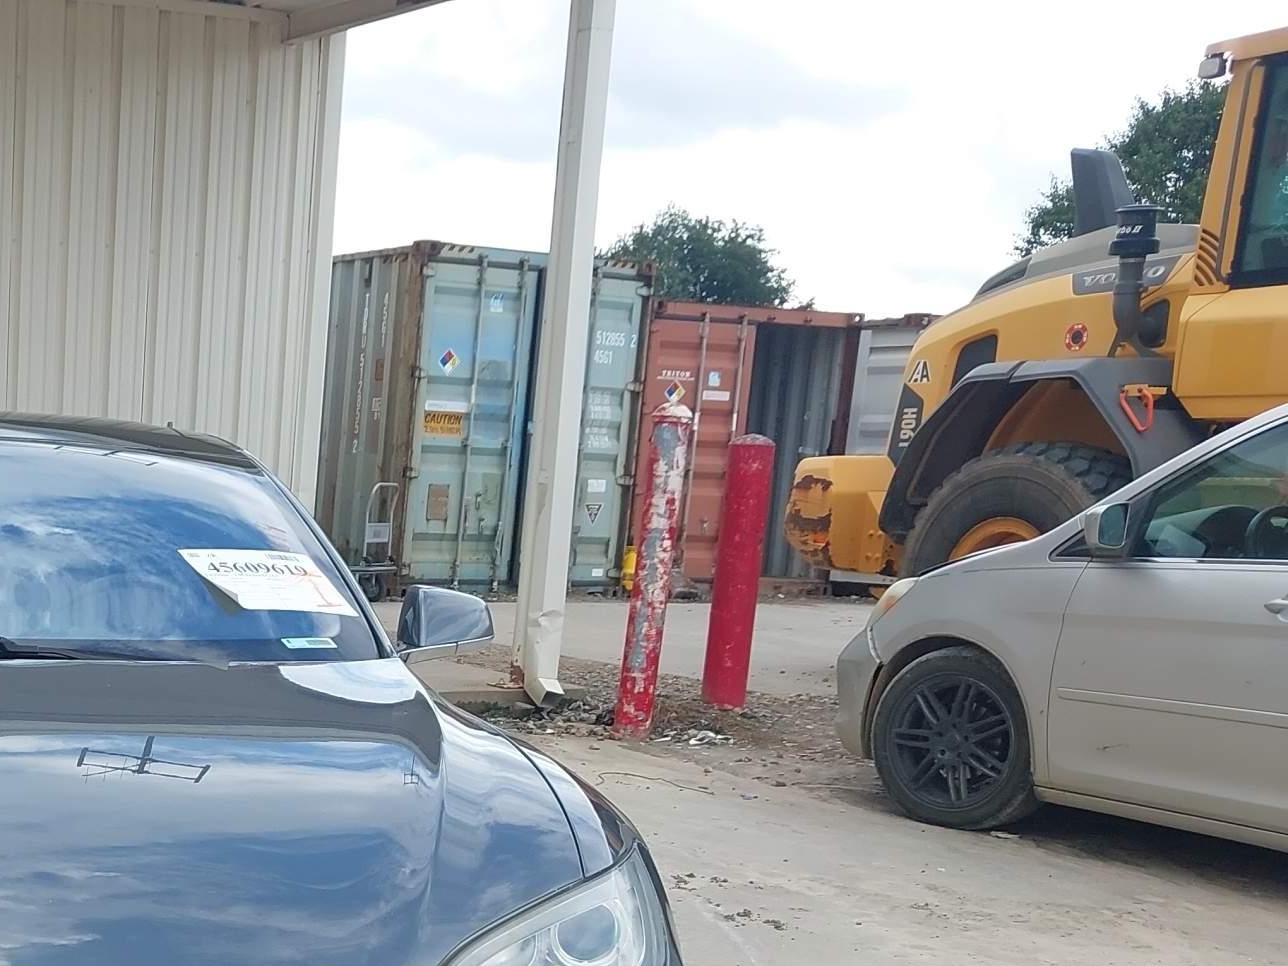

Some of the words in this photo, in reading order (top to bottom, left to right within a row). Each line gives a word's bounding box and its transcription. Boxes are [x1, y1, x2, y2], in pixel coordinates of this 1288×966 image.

[1082, 265, 1166, 287] VOO
[630, 334, 638, 348] 2
[661, 369, 692, 378] TRITON
[424, 413, 463, 425] CAUTION
[207, 561, 309, 577] 45609619
